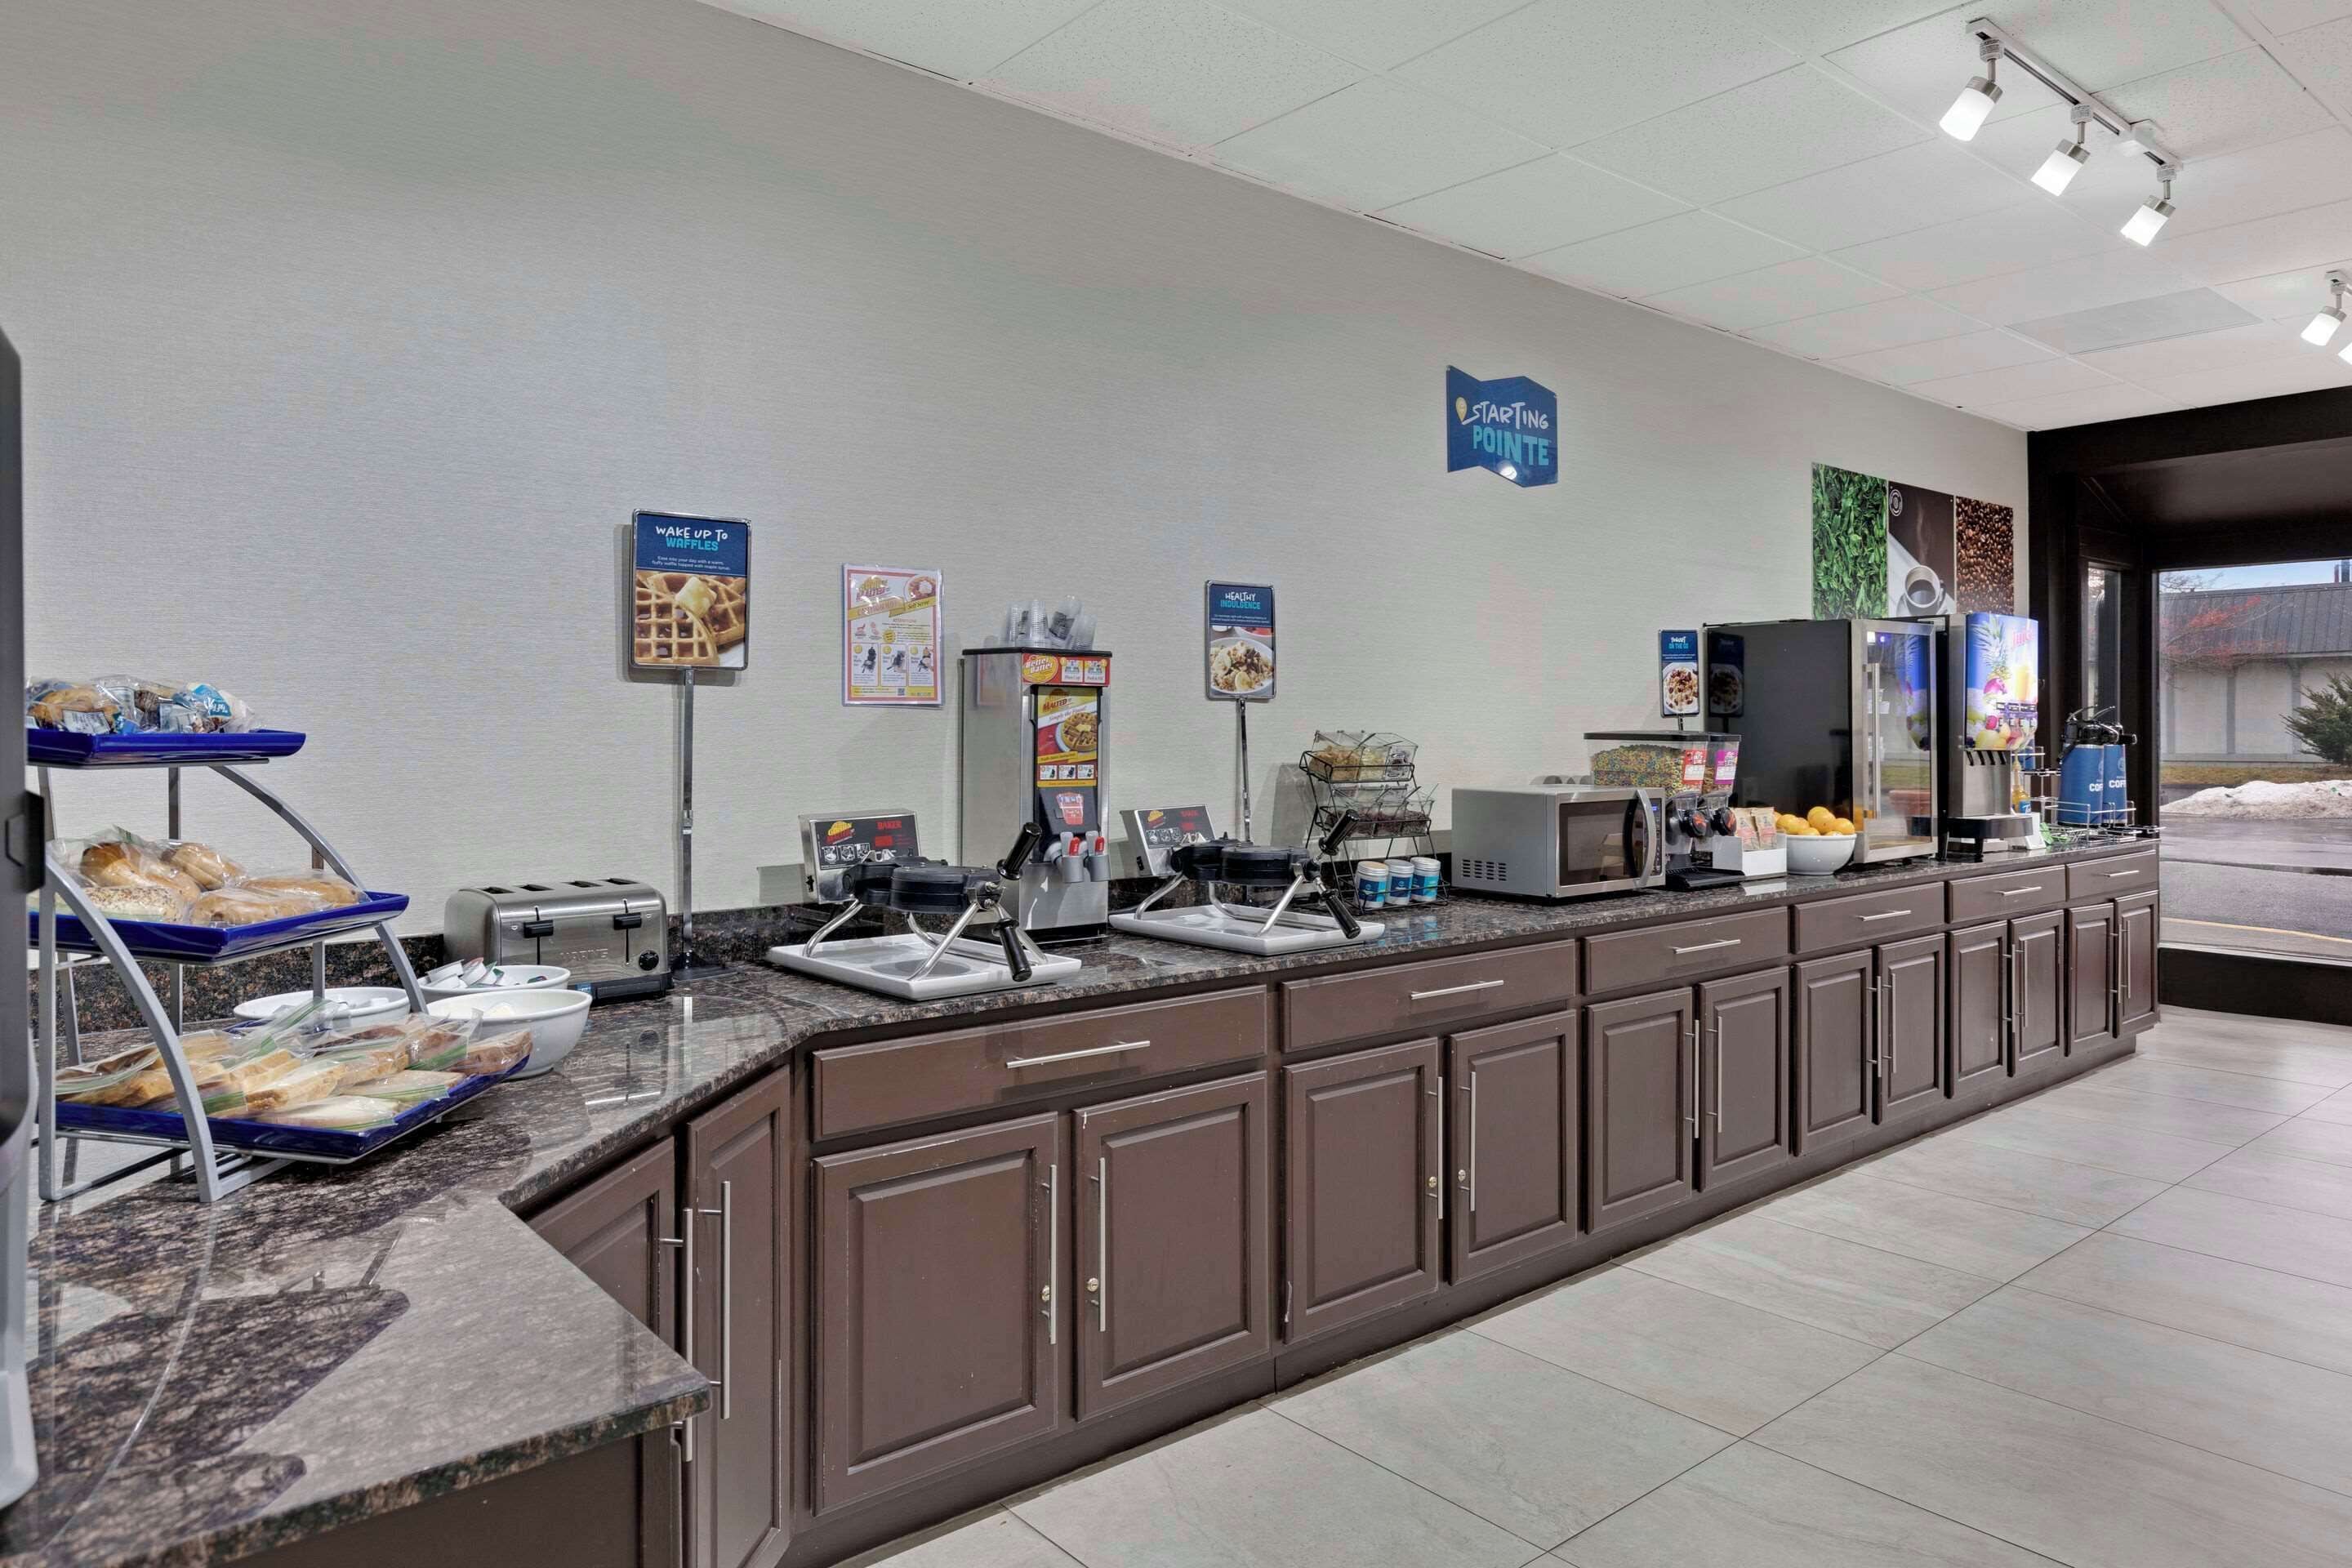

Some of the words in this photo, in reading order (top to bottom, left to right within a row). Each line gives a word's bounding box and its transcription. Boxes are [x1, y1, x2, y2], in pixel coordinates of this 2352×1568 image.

[1462, 401, 1549, 430] STARTING
[1472, 425, 1552, 466] POINTE
[655, 526, 691, 539] WAKE
[694, 529, 712, 539] UP
[666, 537, 719, 551] WAFFLES
[1225, 591, 1256, 601] HEALTHY
[1219, 599, 1261, 609] INDULGENCE
